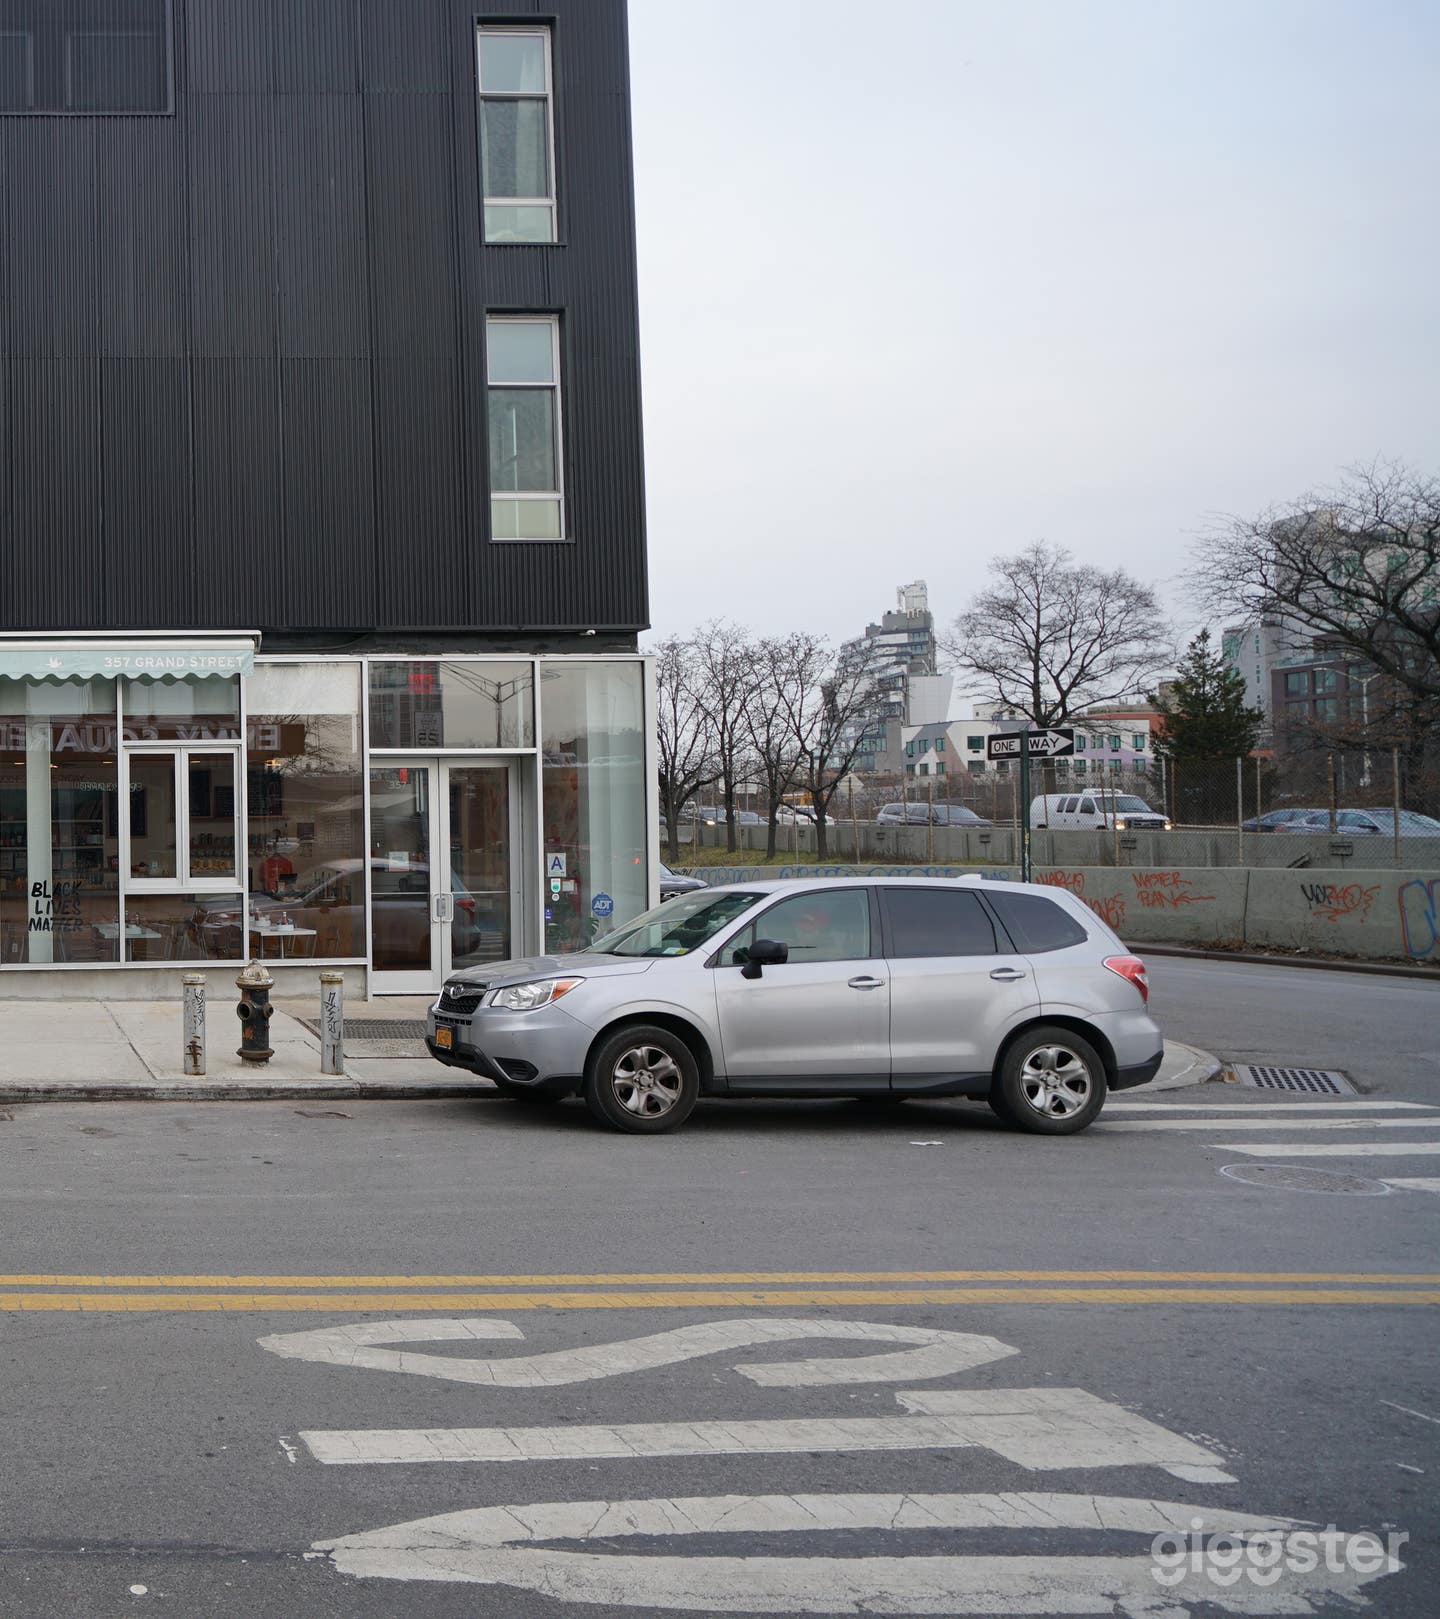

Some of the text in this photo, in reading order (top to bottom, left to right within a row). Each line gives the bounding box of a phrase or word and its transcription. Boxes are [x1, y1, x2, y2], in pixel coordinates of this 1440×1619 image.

[104, 656, 244, 667] 357 GRAND STREET
[993, 737, 1060, 752] ONE WAY
[550, 856, 563, 871] A
[31, 880, 82, 898] BLACK
[35, 899, 81, 915] LIVES
[593, 900, 613, 910] ADT
[28, 916, 83, 932] MATTER
